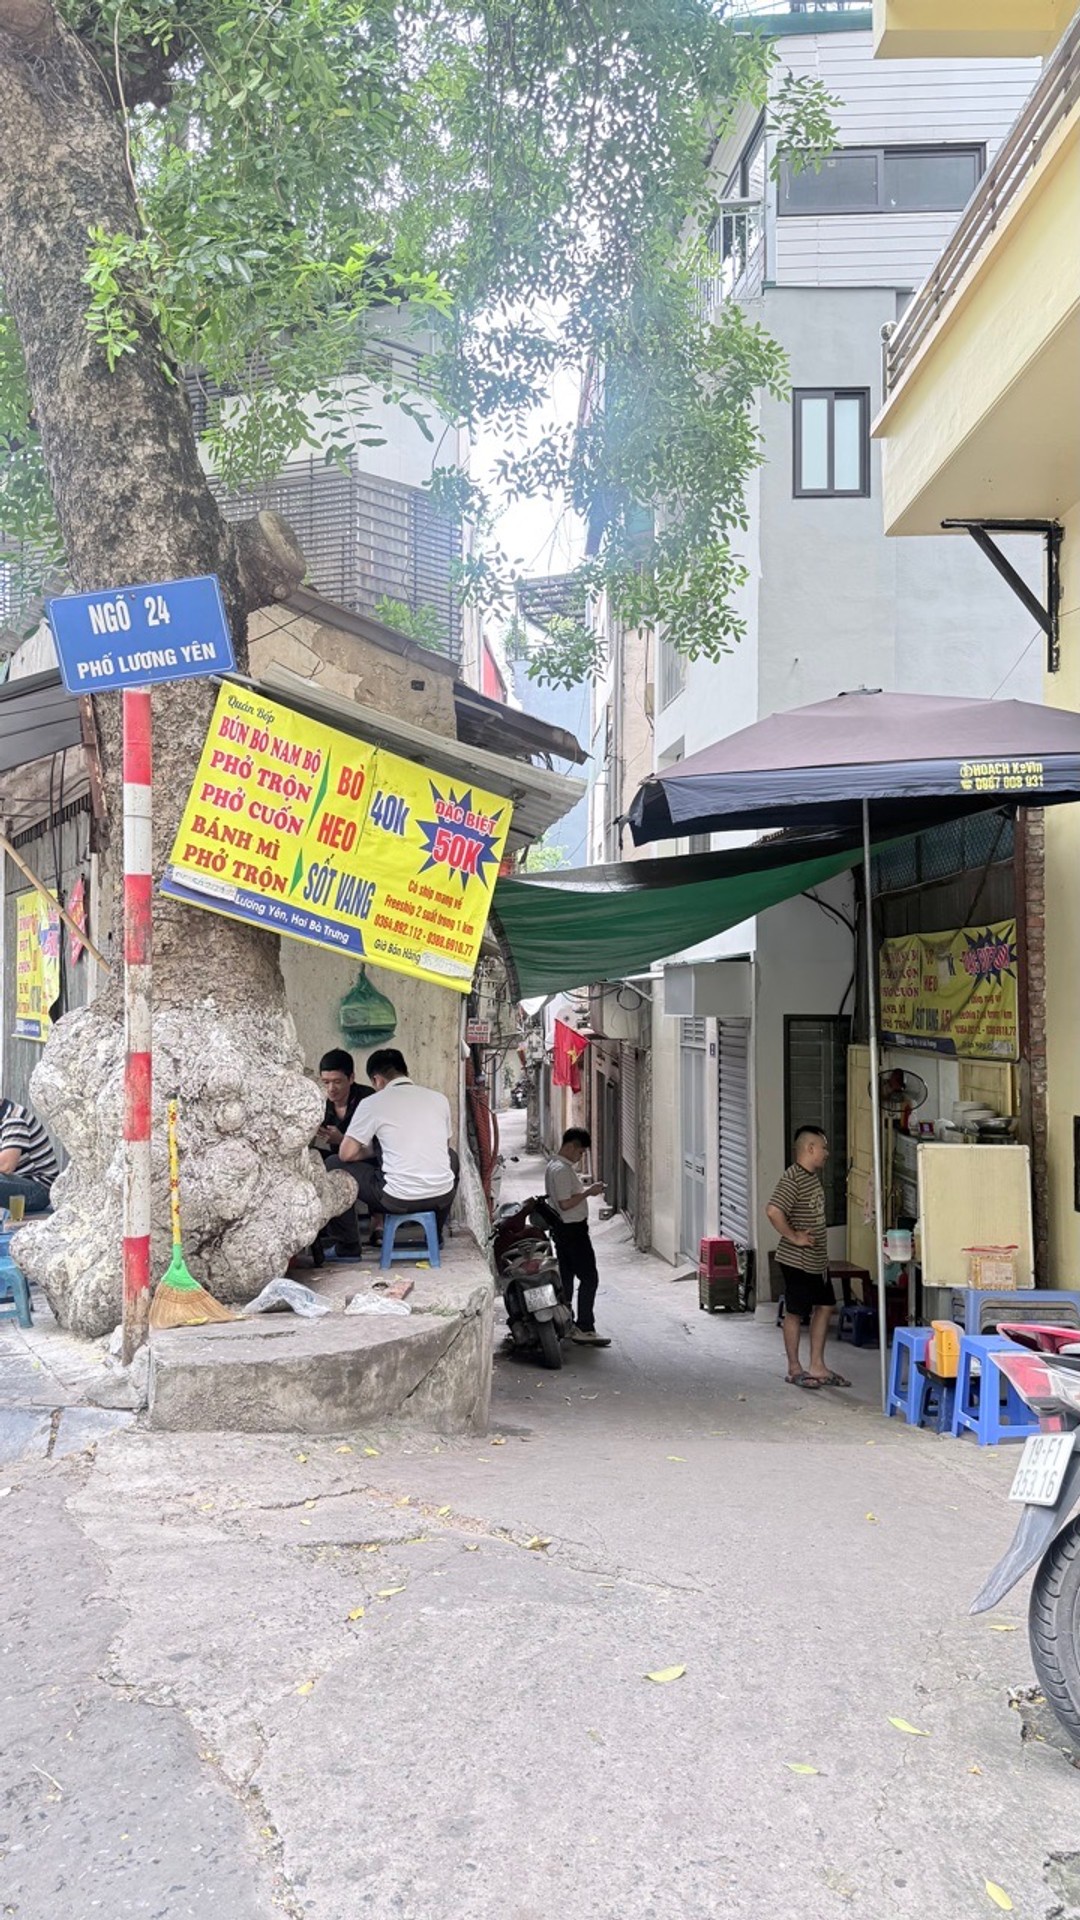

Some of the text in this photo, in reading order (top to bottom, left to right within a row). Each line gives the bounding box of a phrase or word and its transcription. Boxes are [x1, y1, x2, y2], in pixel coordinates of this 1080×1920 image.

[88, 594, 171, 635] NGÕ 24
[77, 641, 217, 679] PHỐ LƯƠNG YÊN
[228, 695, 254, 714] Quán
[219, 715, 322, 778] BÚN BÒ NAM BỘ
[210, 749, 313, 803] PHỞ TRỘN
[336, 764, 365, 801] BÒ
[200, 783, 304, 836] PHỞ CUỐN
[370, 791, 410, 836] 40K
[435, 799, 497, 836] ĐẶC BIỆT
[191, 815, 280, 861] BÁNH MÌ
[317, 812, 357, 852] HEO
[432, 827, 484, 875] 50K
[182, 843, 229, 872] PHỞ
[232, 860, 288, 894] TRỘN
[303, 854, 376, 920] SỐT VANG
[384, 894, 474, 935] Freeship 2 suất trong 1 km
[419, 885, 434, 900] ship
[435, 892, 453, 908] mang
[234, 894, 350, 944] Lương Yên, Hai Bà Trưng
[388, 943, 401, 956] Bán
[402, 948, 421, 965] Hàng
[1028, 1437, 1064, 1466] 19-F1
[1012, 1469, 1058, 1498] 353.16
